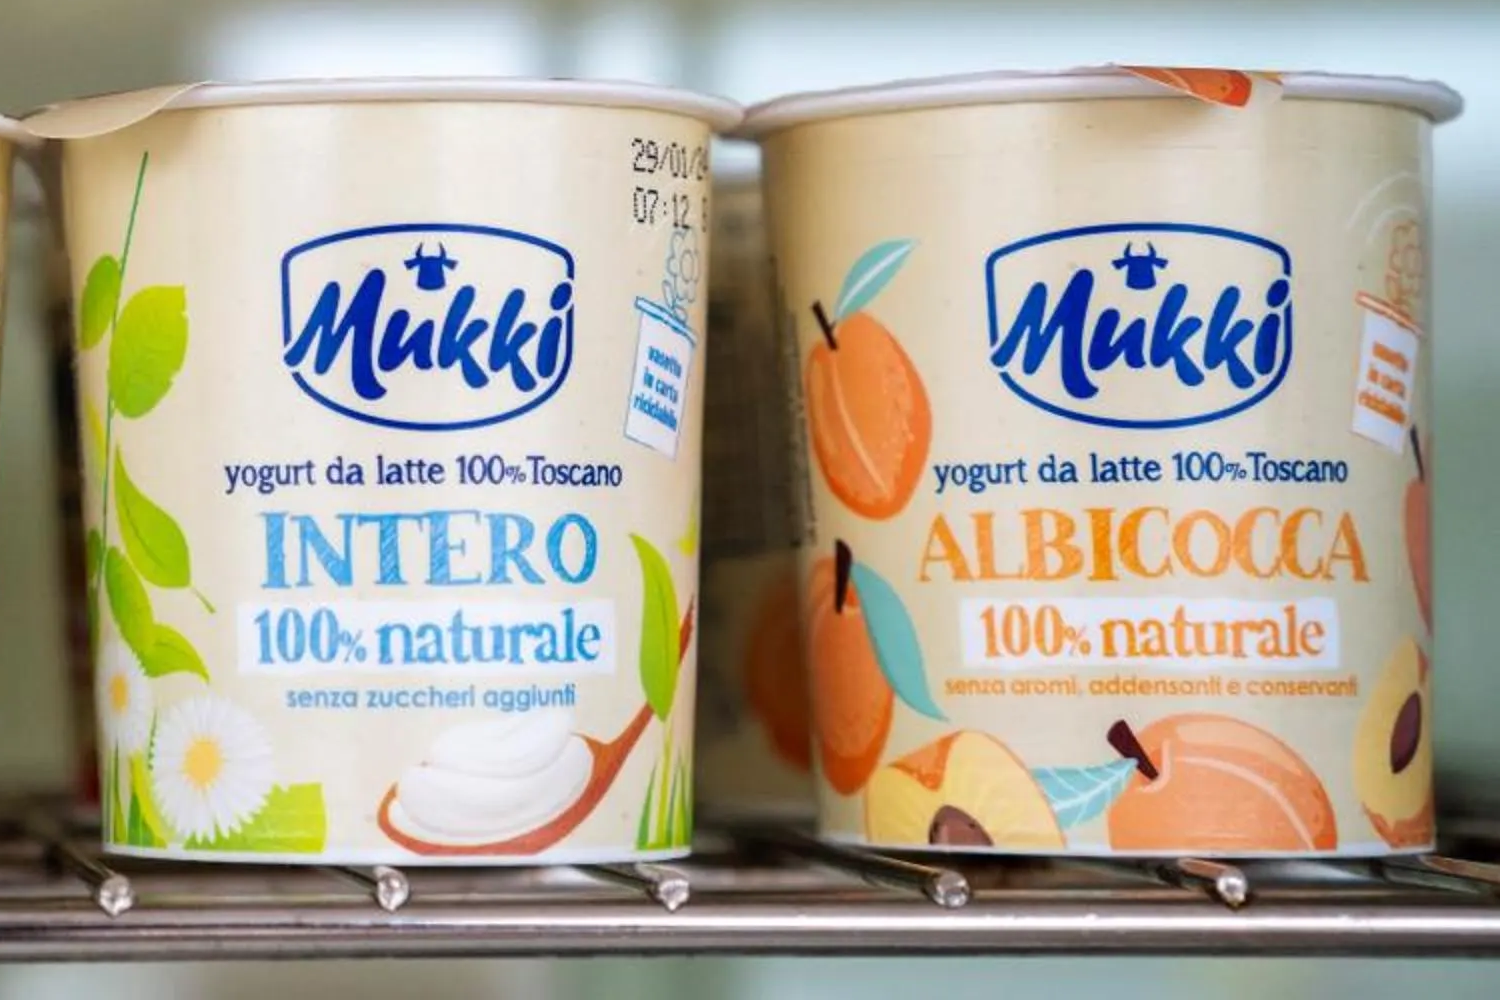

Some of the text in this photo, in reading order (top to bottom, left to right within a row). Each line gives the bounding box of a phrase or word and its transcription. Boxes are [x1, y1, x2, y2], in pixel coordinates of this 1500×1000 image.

[631, 186, 690, 230] 07:12
[283, 268, 574, 400] Mukki
[991, 268, 1292, 400] Mukki
[224, 459, 315, 494] yogurt
[326, 457, 365, 486] da
[377, 455, 445, 485] latte
[933, 457, 1027, 493] yogurt
[1038, 453, 1078, 483] da
[1090, 453, 1162, 482] latte
[258, 509, 599, 589] INTERO
[916, 506, 1370, 582] ALBICOCCA
[254, 607, 601, 665] 100% naturale
[979, 604, 1326, 658] 100% naturale
[286, 683, 576, 713] senza zuccheri aggiunti
[945, 679, 1005, 696] senza
[1088, 675, 1221, 696] addensanti
[1227, 680, 1240, 695] e
[1246, 676, 1358, 697] conservanti
